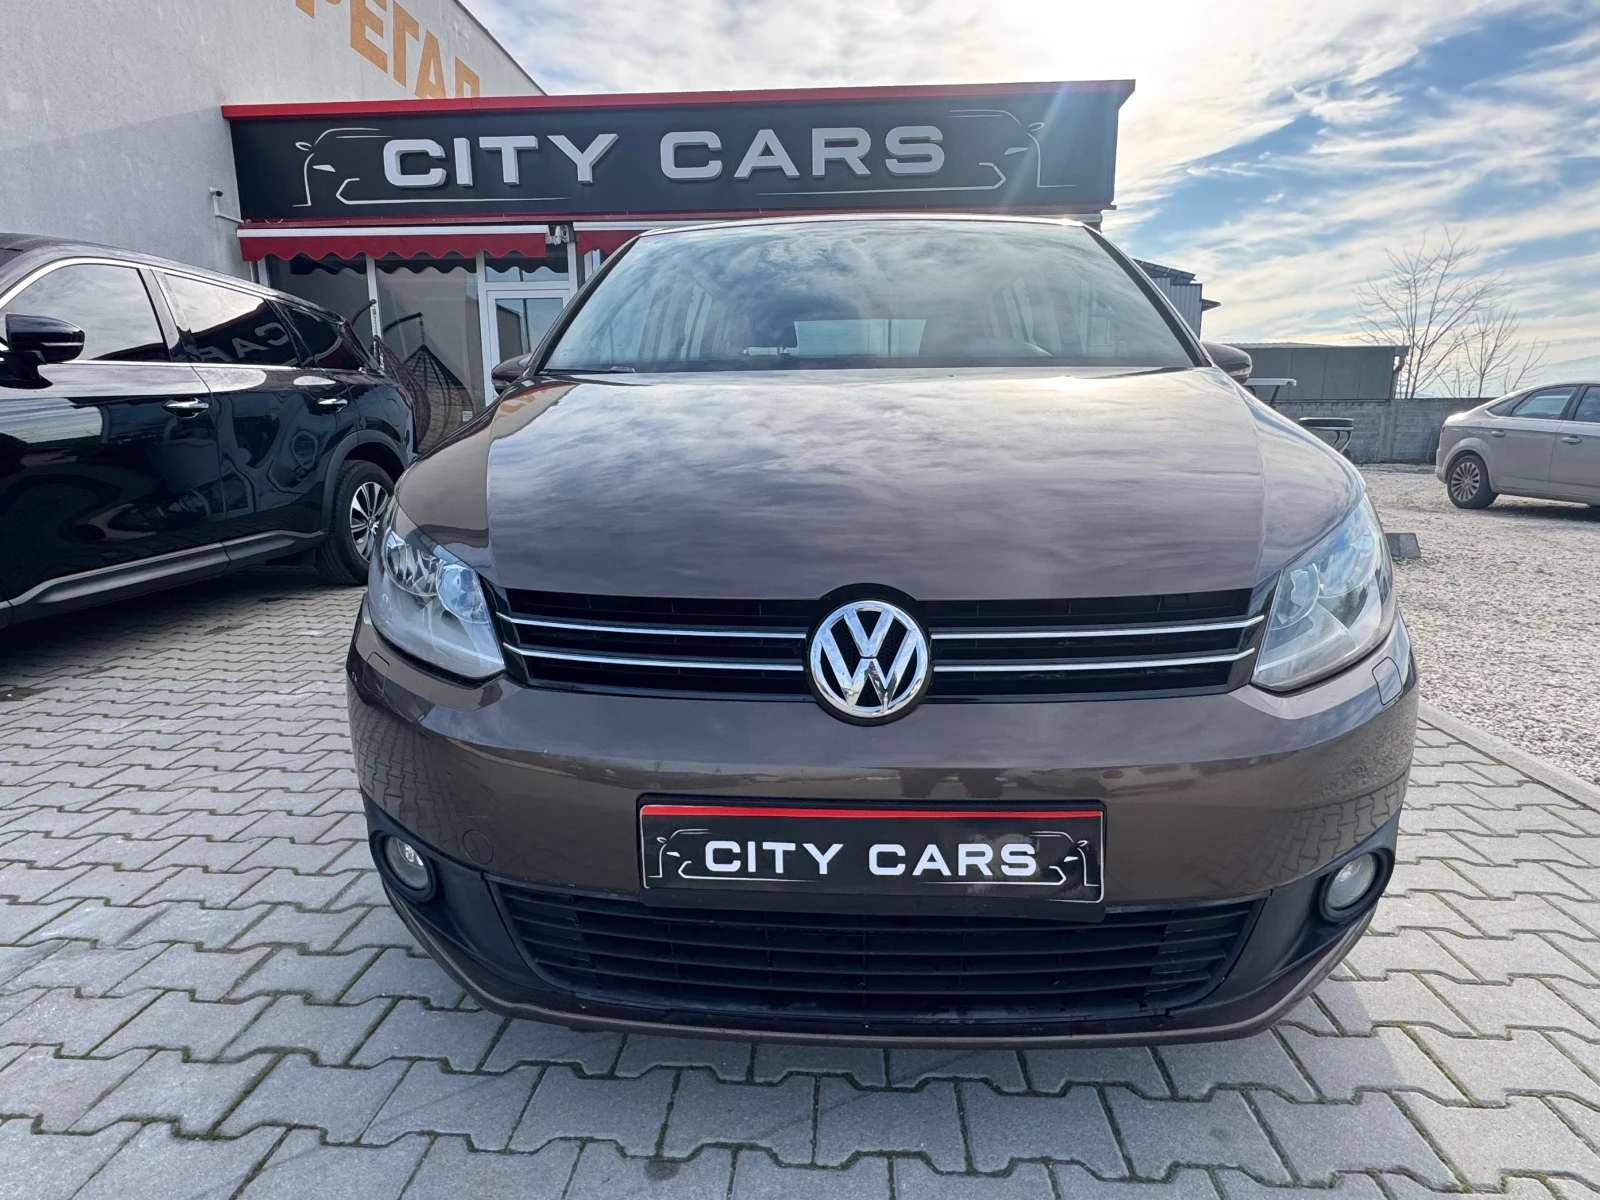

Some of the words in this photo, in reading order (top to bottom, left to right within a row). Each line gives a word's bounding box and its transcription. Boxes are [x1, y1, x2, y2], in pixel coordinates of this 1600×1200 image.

[295, 0, 480, 99] ЕГА
[382, 133, 618, 188] CITY
[659, 125, 946, 181] CARS
[704, 840, 844, 875] CITY
[868, 843, 1037, 876] CARS
